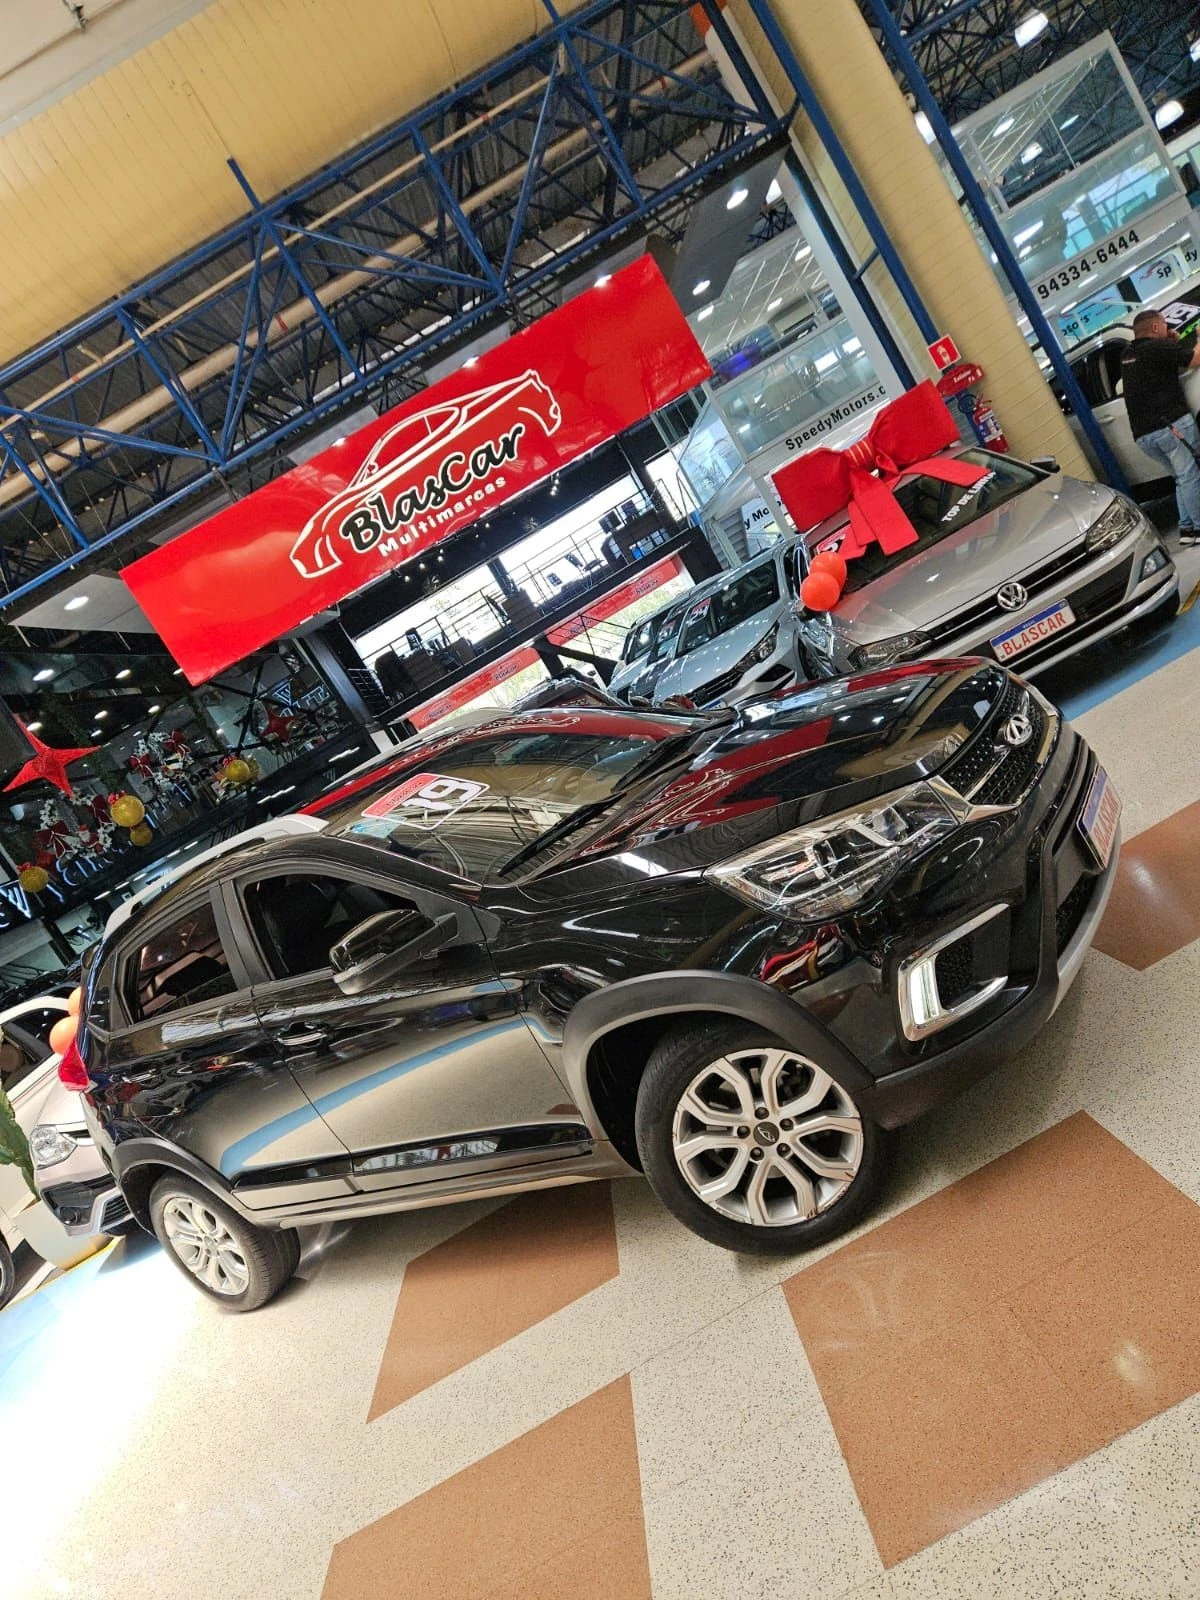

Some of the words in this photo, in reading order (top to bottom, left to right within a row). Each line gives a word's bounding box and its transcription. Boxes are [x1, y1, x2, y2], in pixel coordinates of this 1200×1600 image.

[1037, 229, 1140, 299] 94334-6444
[340, 424, 525, 553] BlasCar
[377, 477, 506, 557] Multimarcas
[941, 505, 960, 521] TOP
[957, 493, 974, 505] DE
[1001, 612, 1067, 656] BLASCAR
[401, 779, 481, 811] 19
